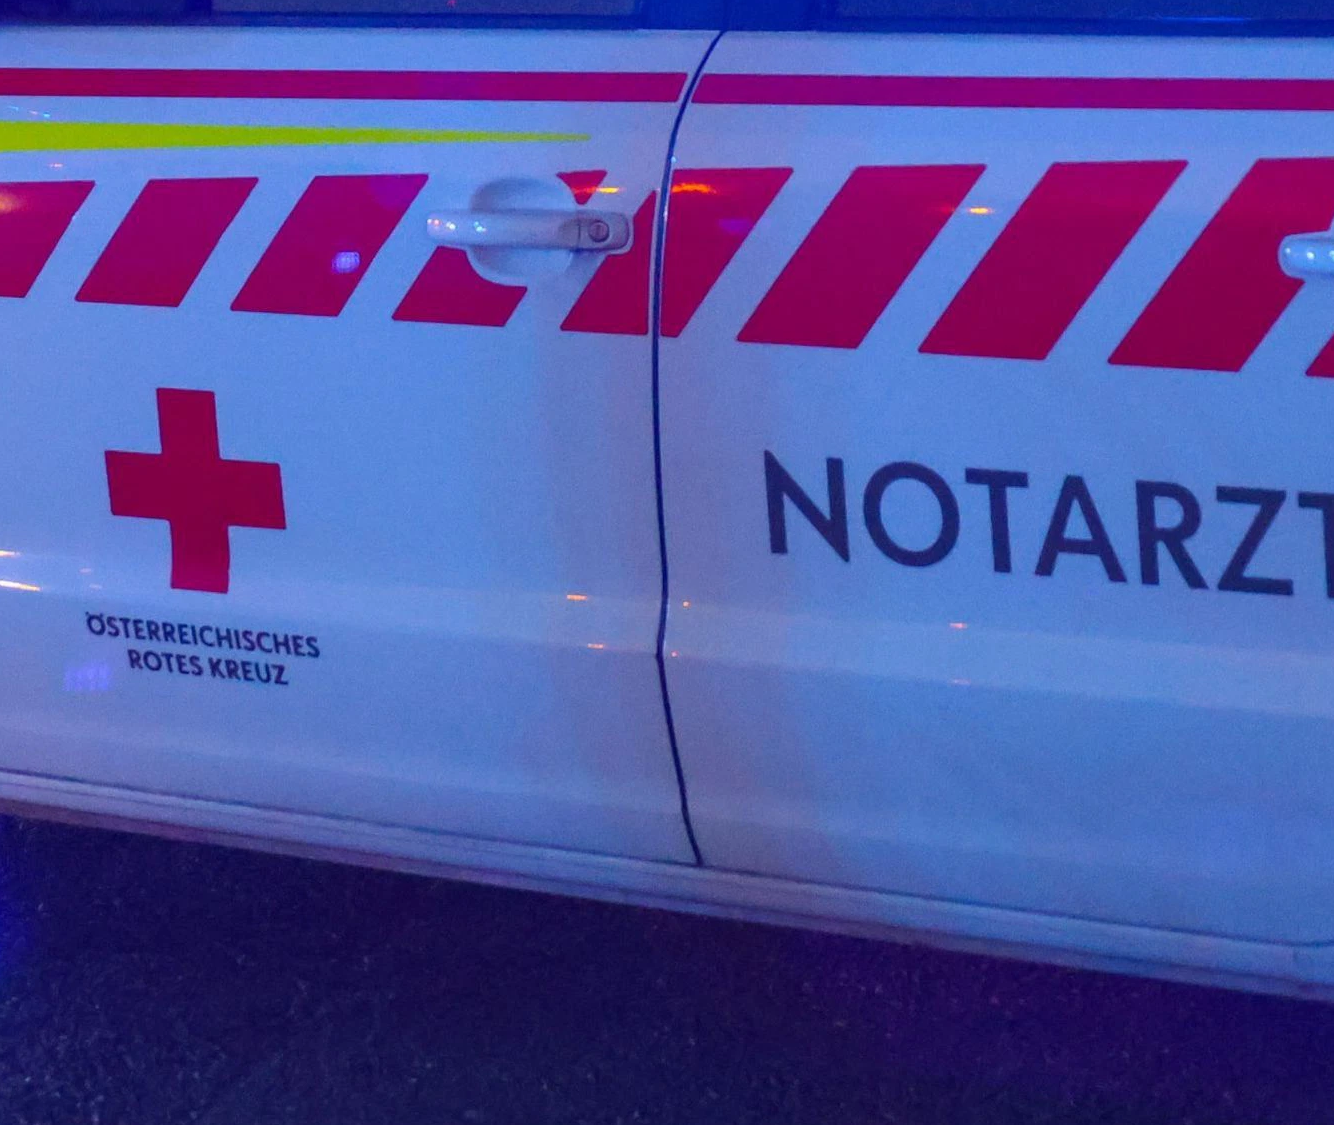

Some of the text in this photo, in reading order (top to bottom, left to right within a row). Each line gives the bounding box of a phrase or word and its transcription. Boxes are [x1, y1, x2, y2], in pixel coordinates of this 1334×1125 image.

[85, 611, 321, 658] ÖSTERREICHISCHES
[126, 648, 290, 686] ROTES KREUZ
